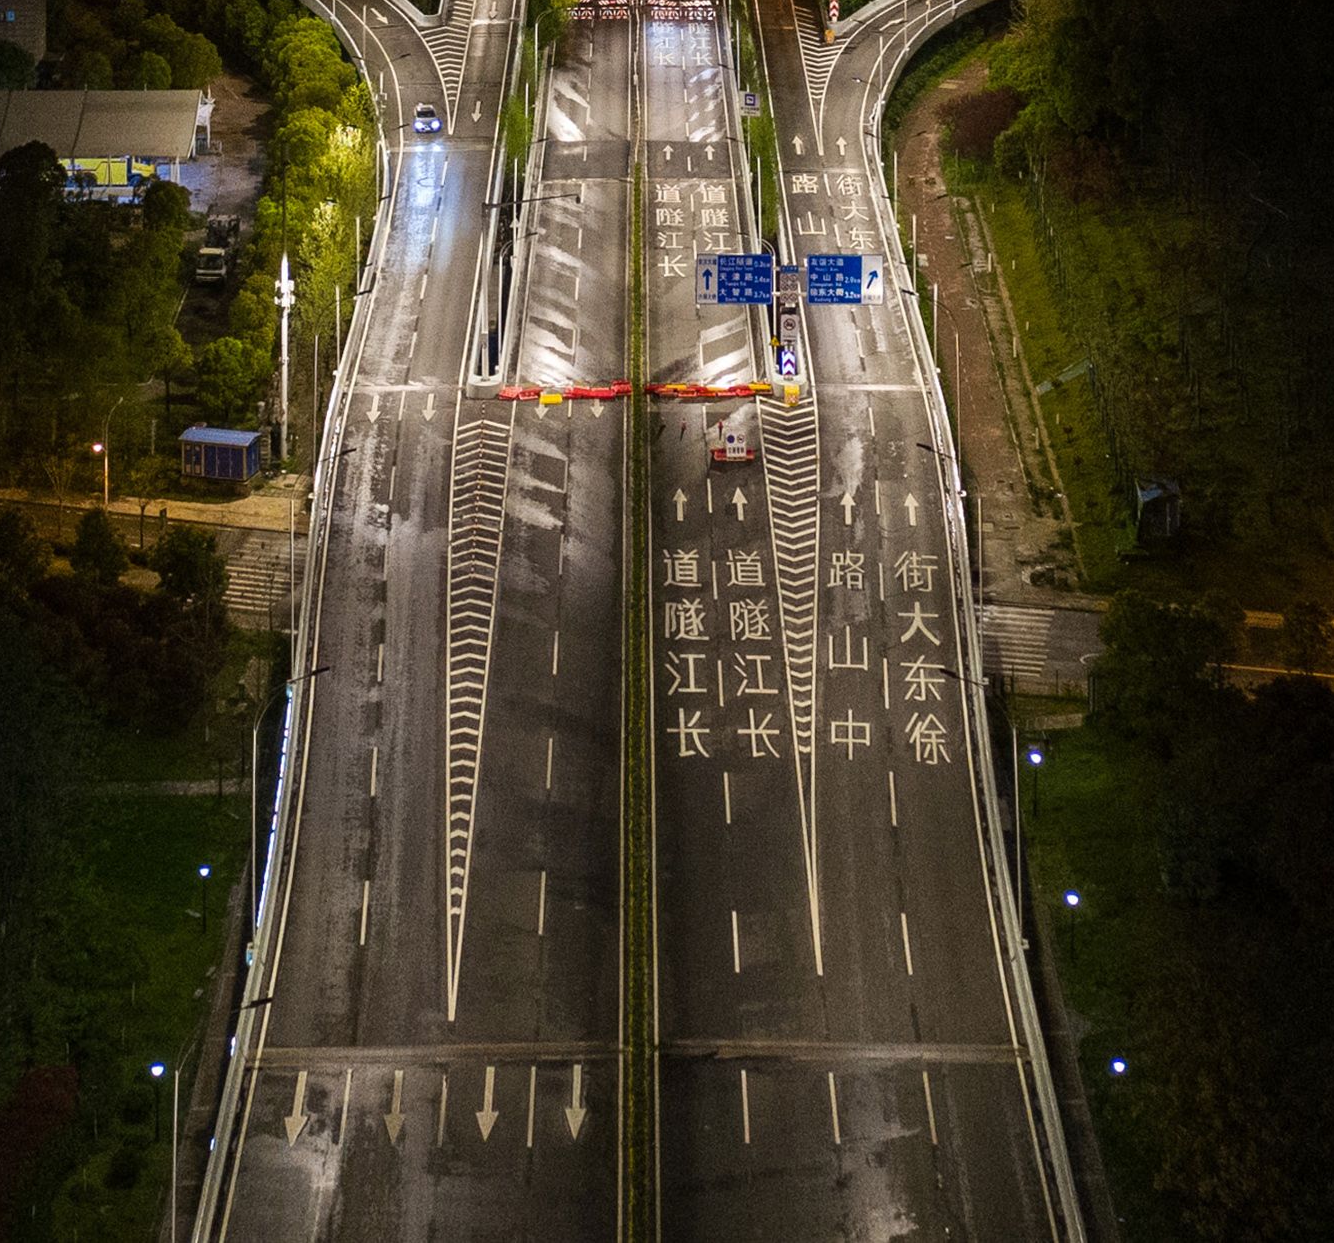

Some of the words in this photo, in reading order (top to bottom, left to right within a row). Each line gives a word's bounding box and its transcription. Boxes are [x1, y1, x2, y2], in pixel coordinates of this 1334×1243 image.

[652, 22, 676, 65] 长江隧
[688, 22, 713, 66] 长江隧
[700, 184, 732, 252] 江隧道
[792, 174, 827, 236] 山路
[836, 174, 875, 250] 东大街
